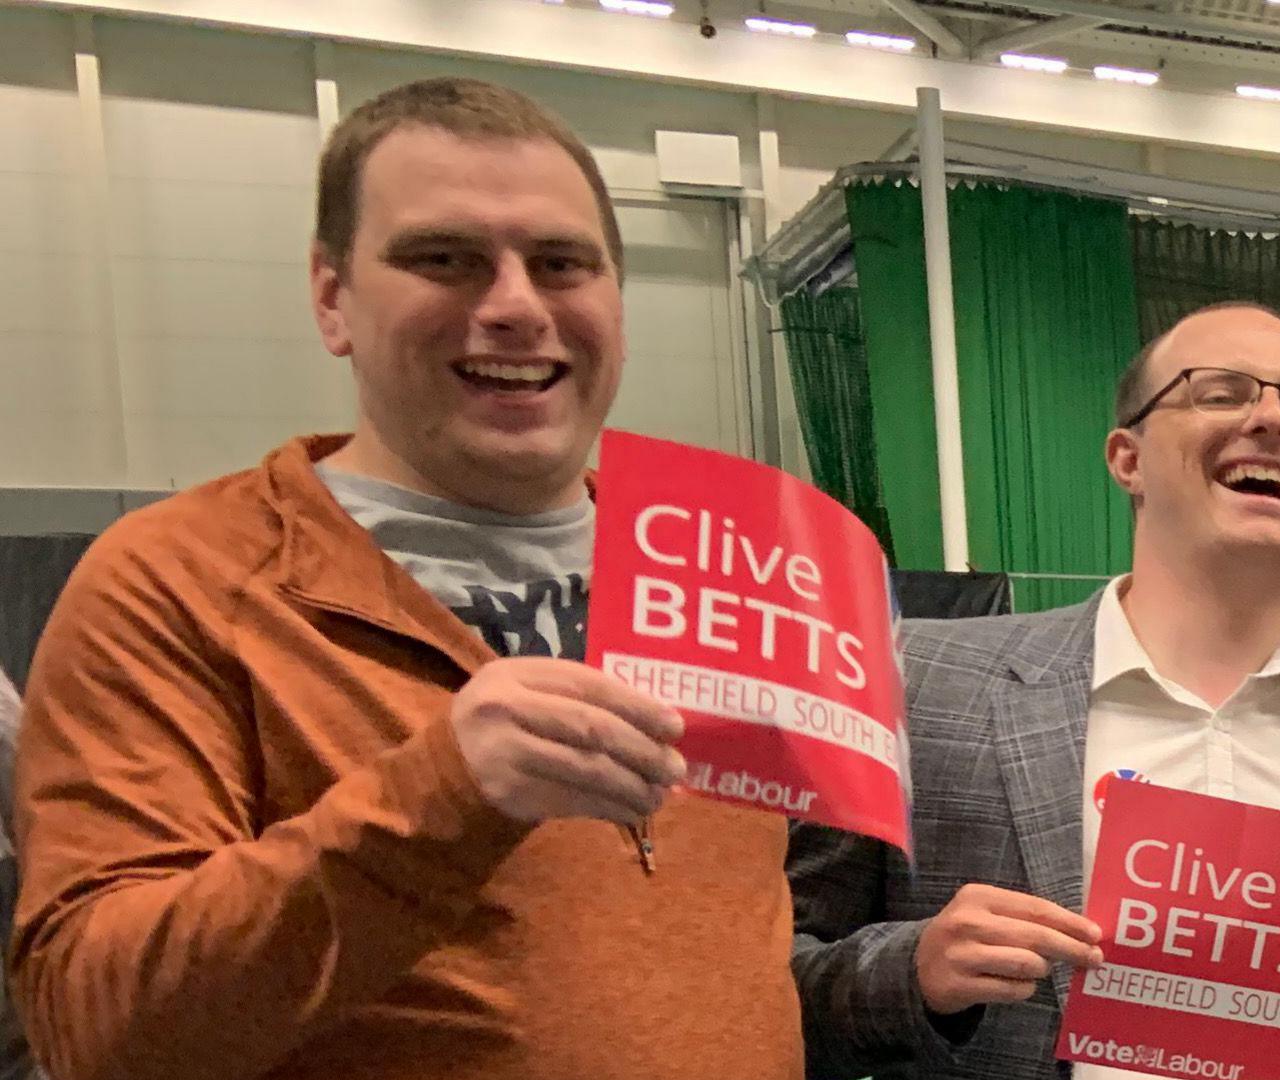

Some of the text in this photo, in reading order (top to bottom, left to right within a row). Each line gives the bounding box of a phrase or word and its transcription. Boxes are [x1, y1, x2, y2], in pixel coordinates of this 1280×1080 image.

[634, 504, 822, 602] Clive
[632, 575, 867, 690] BETTS
[794, 701, 876, 748] SOUTH
[702, 764, 818, 813] Labour
[1124, 839, 1277, 909] Clive
[1091, 966, 1218, 1010] SHEFFIELD
[1068, 1032, 1135, 1064] Vote
